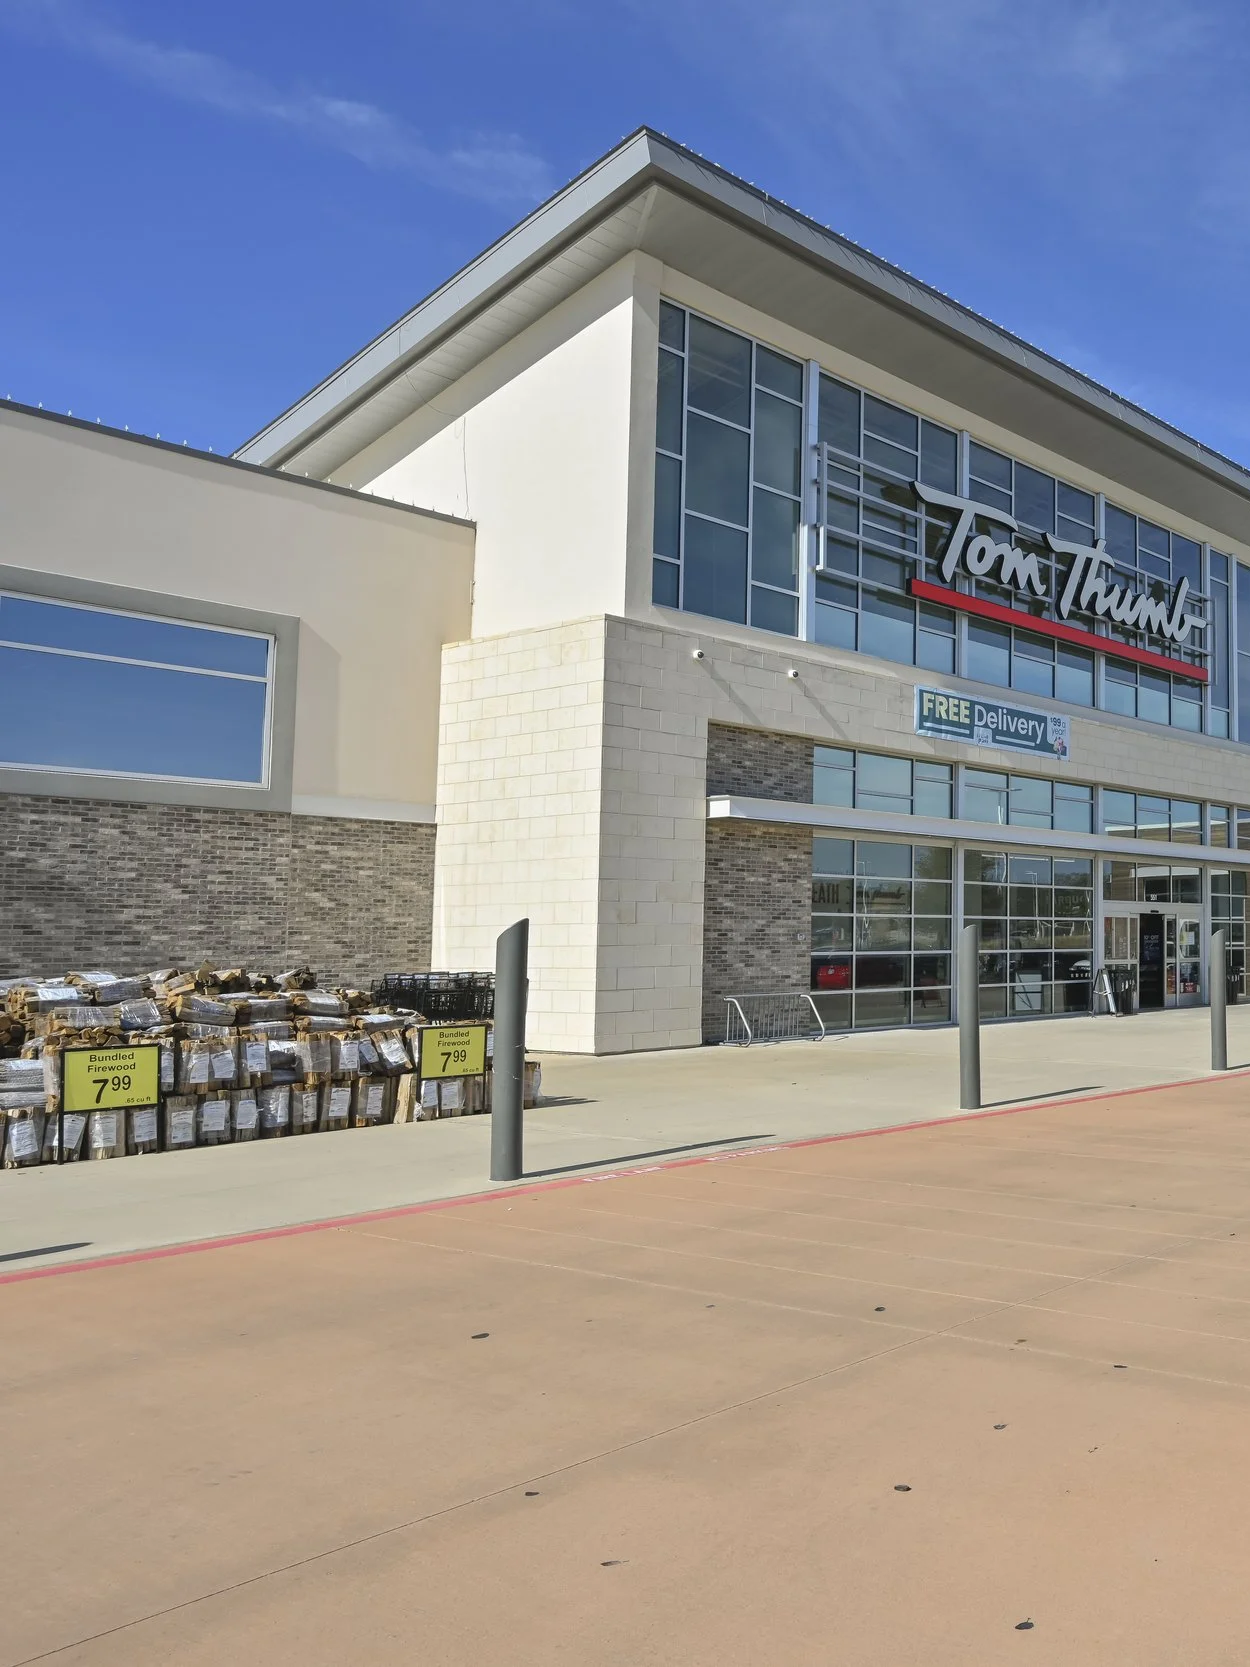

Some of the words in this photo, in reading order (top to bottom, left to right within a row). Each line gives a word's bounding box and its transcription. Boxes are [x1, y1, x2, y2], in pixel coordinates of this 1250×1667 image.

[910, 480, 1046, 596] Tom
[1041, 532, 1207, 642] Thumb
[923, 692, 971, 724] FREE
[974, 704, 1045, 744] Delivery
[437, 1039, 471, 1047] Firewood
[89, 1052, 135, 1063] Bundled
[87, 1062, 136, 1073] Firewood
